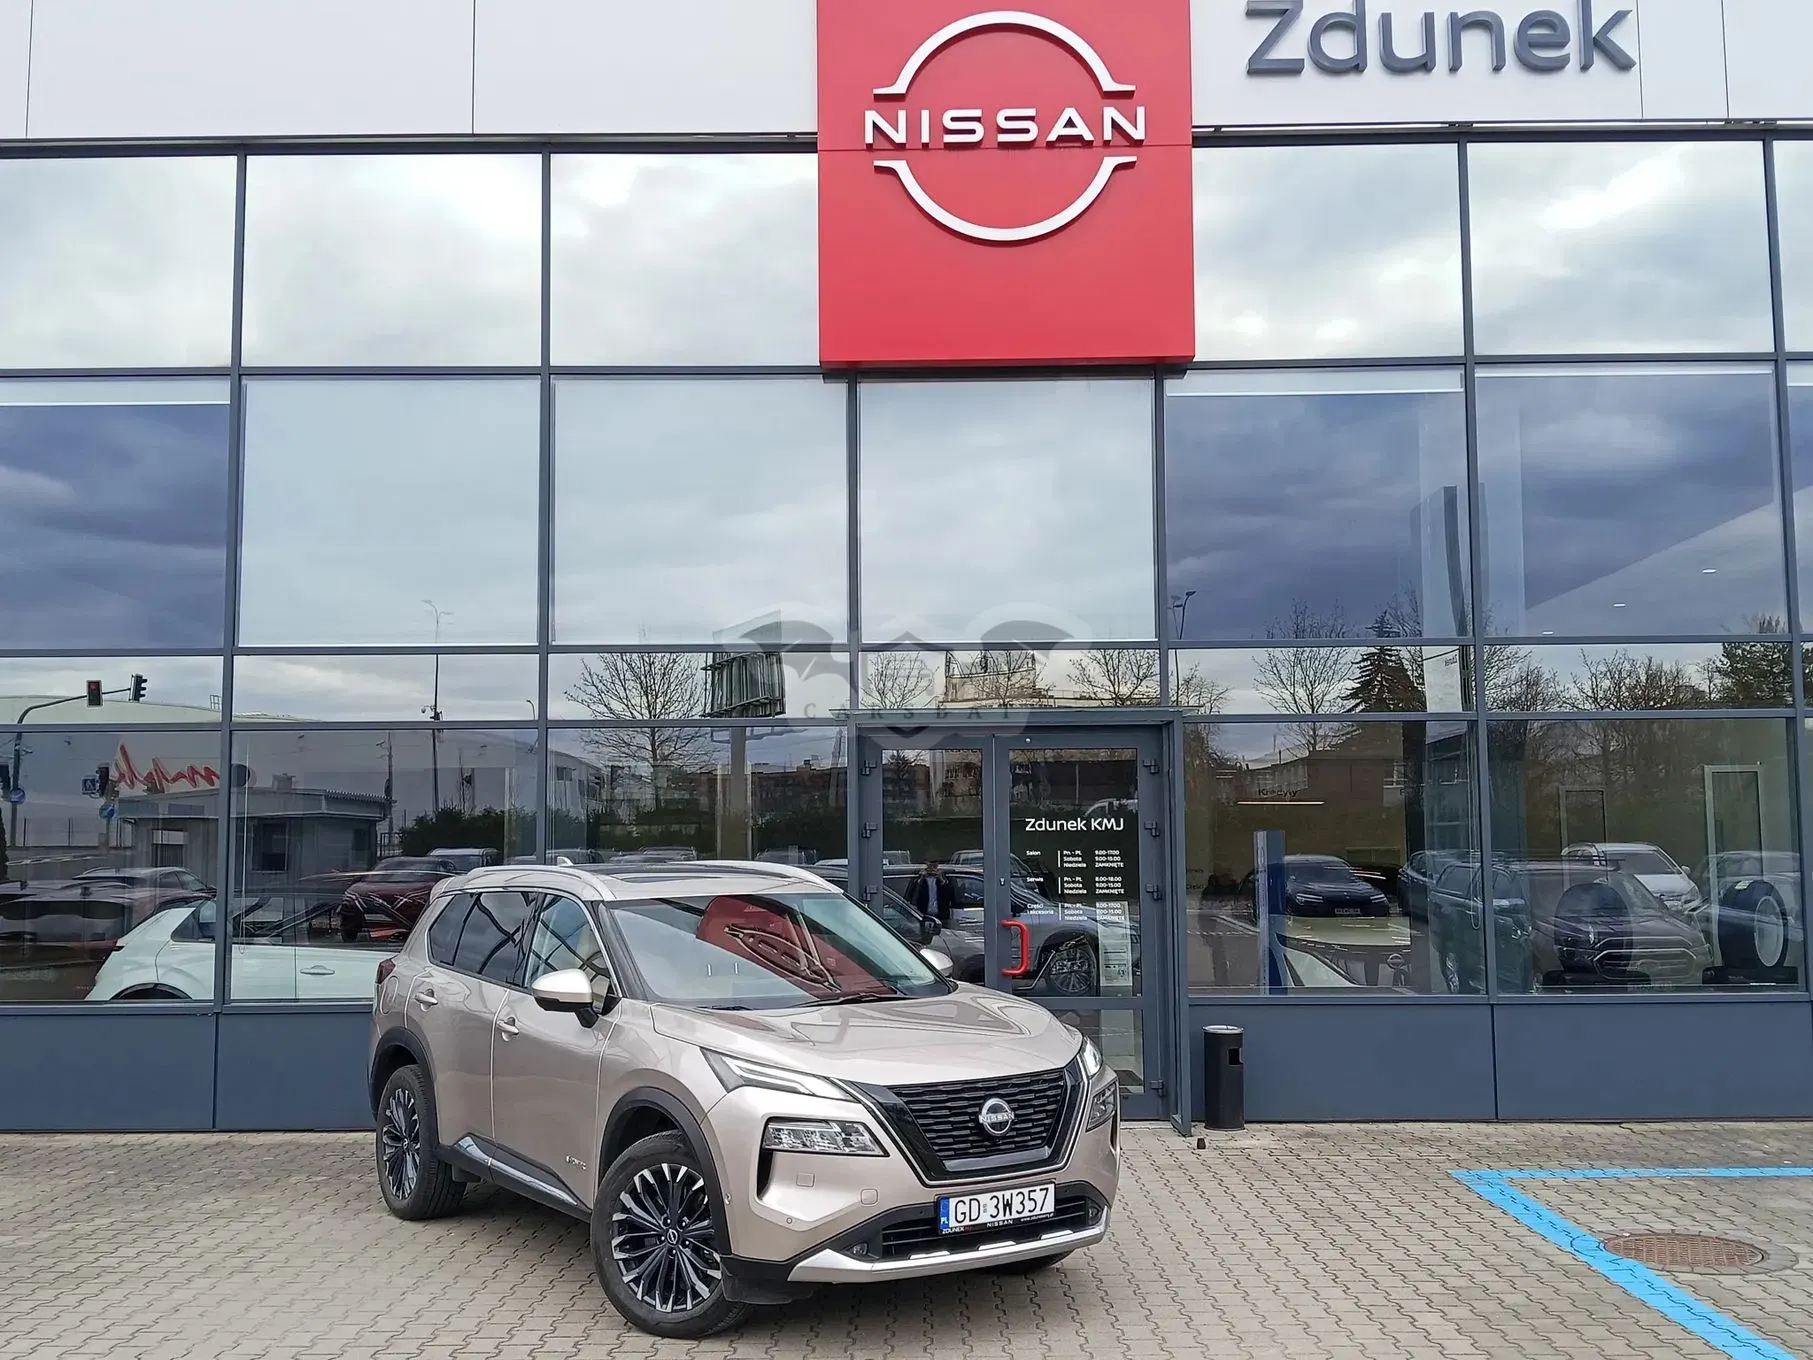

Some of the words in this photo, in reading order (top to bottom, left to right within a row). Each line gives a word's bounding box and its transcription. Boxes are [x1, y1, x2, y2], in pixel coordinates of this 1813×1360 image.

[1246, 0, 1637, 74] Zdunek
[864, 106, 1146, 146] NISSAN
[1025, 817, 1087, 831] Zdunek
[1091, 817, 1124, 831] KMJ
[979, 1111, 1014, 1123] NISSAN
[955, 1198, 980, 1224] GD
[990, 1187, 1049, 1218] 3W357
[940, 1216, 948, 1225] PL
[986, 1219, 1014, 1228] NISSAN
